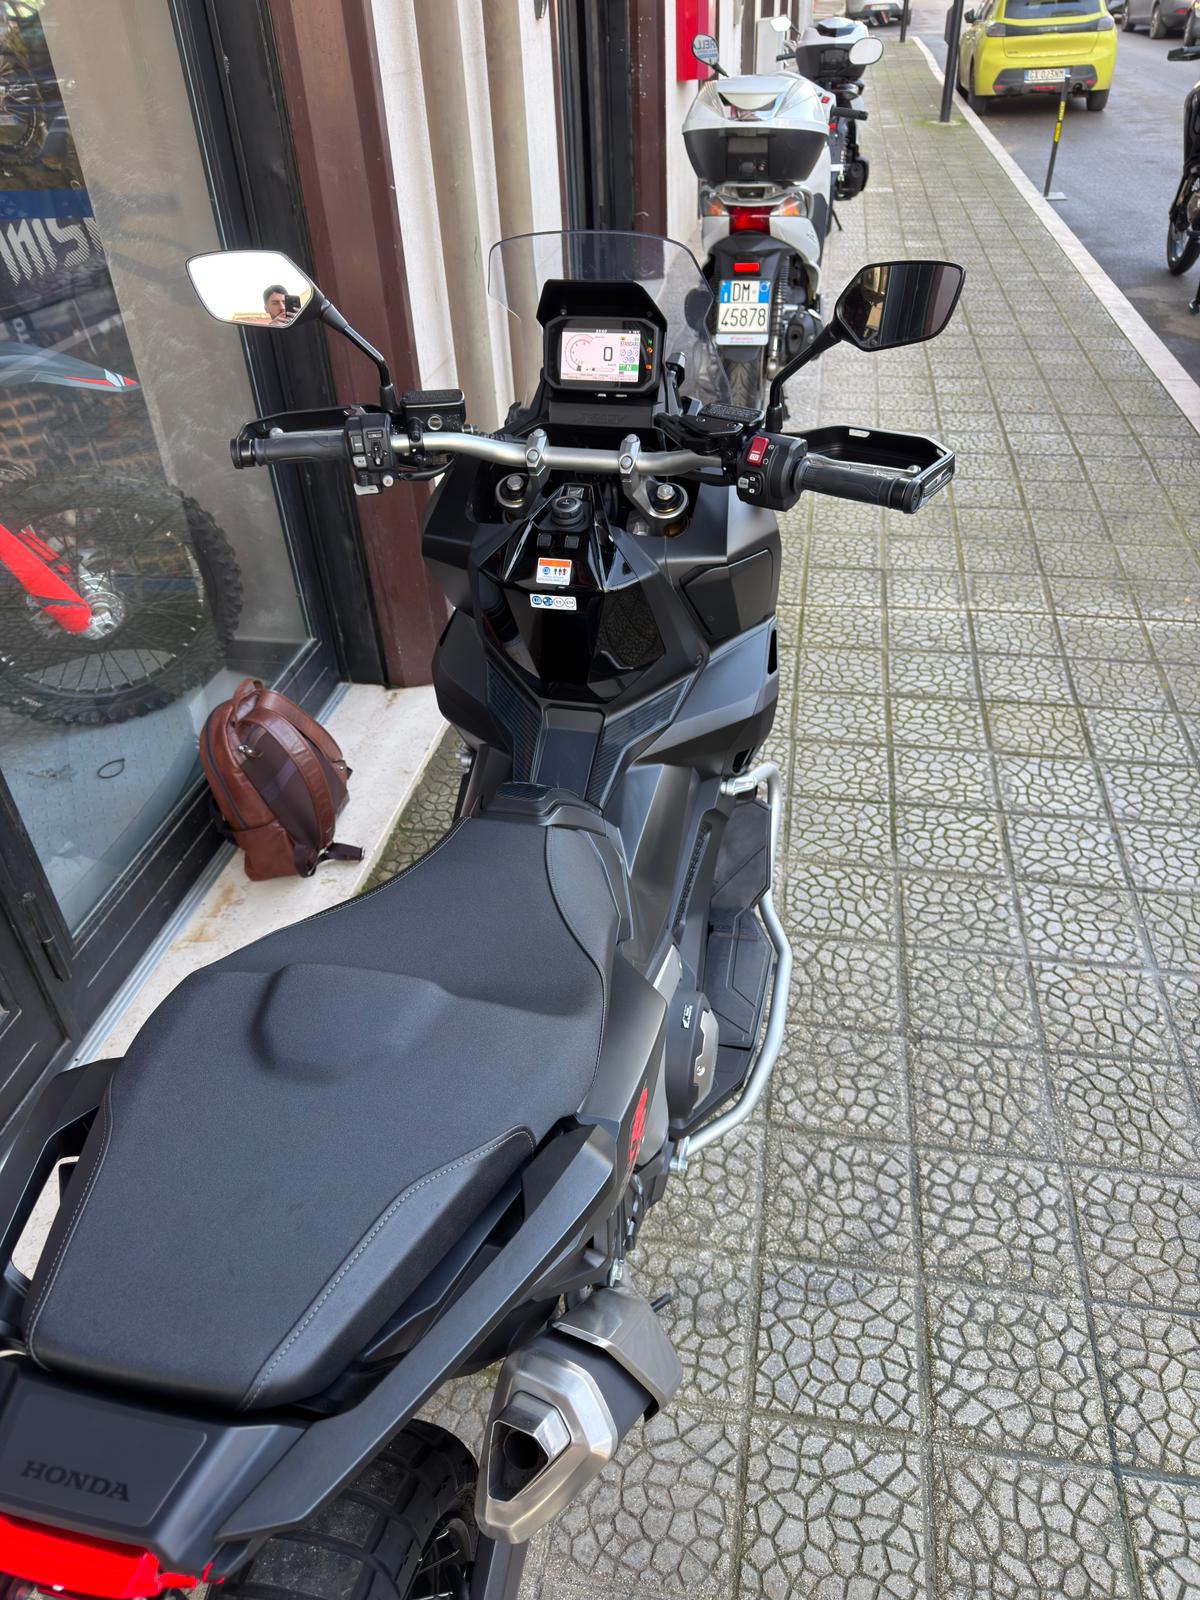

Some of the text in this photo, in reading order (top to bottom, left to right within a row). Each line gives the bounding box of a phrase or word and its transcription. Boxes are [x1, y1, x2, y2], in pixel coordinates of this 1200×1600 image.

[732, 282, 751, 302] DM
[720, 307, 767, 327] 45878
[603, 346, 613, 362] 0
[20, 1459, 131, 1503] HONDA
